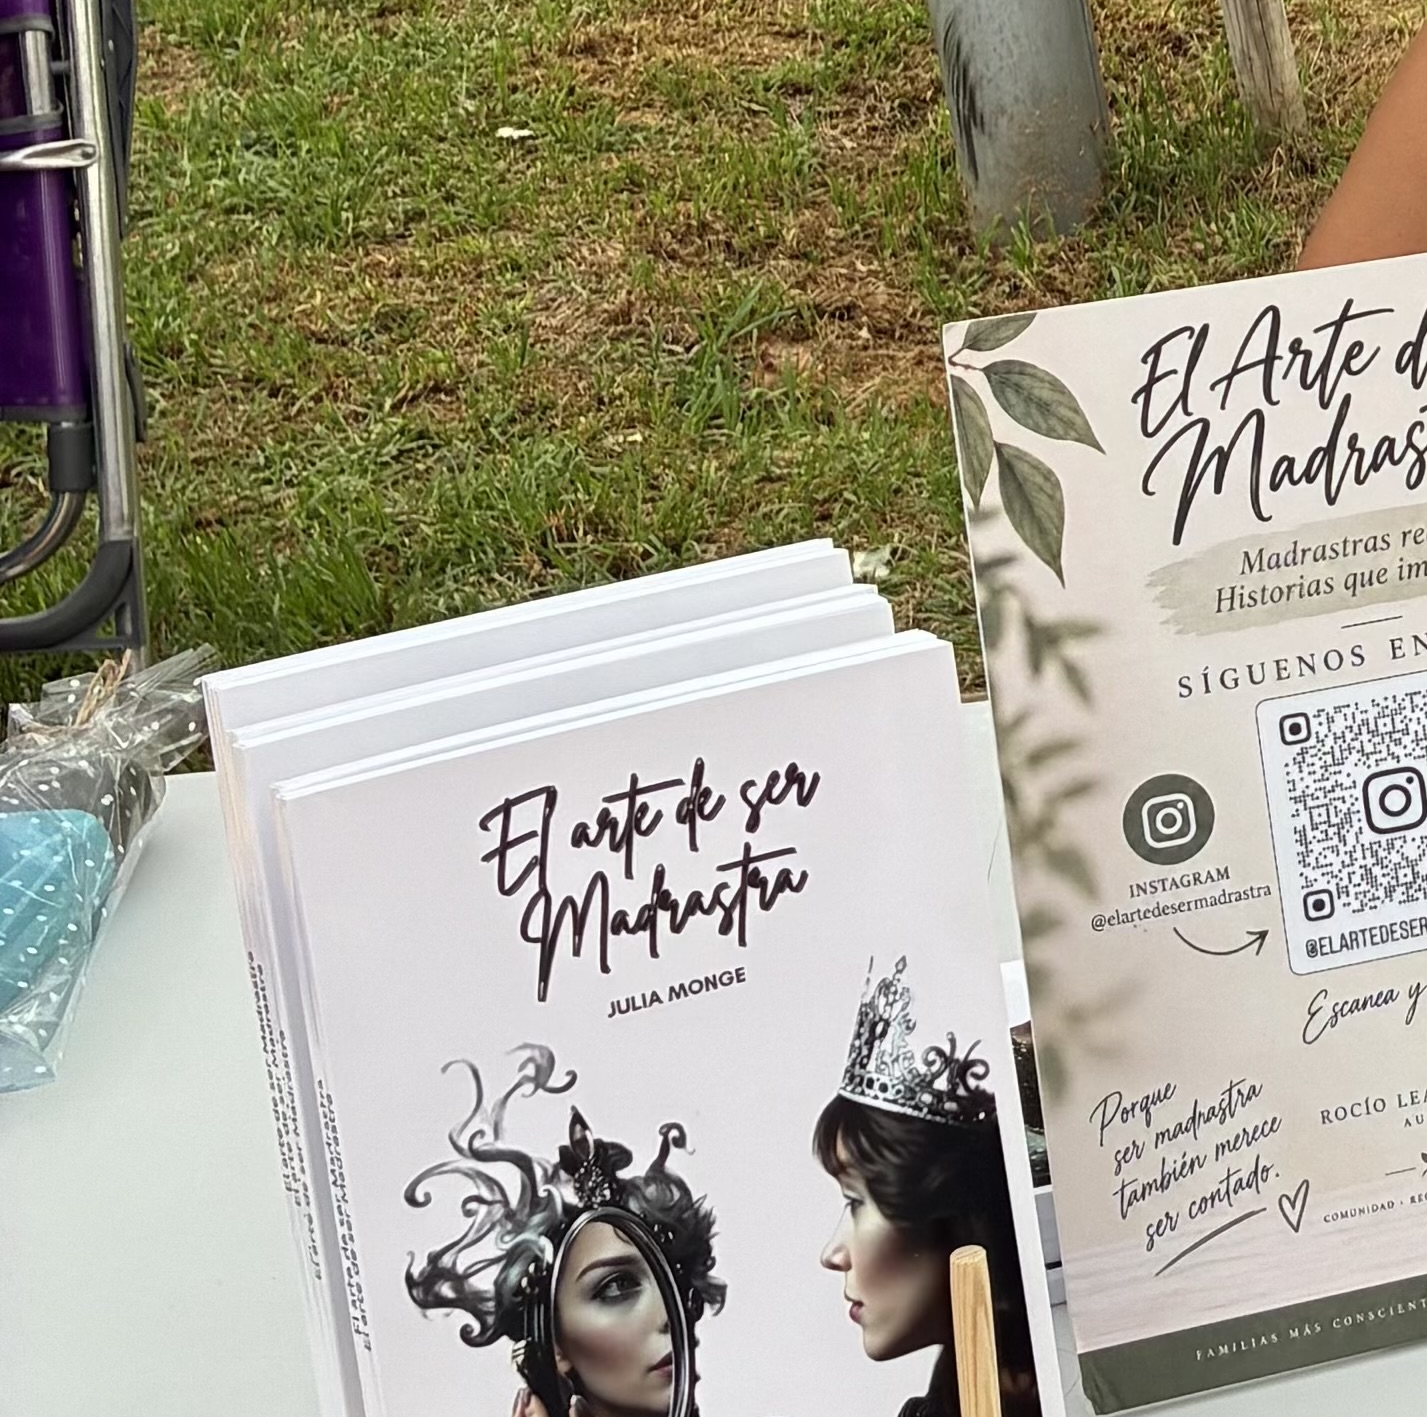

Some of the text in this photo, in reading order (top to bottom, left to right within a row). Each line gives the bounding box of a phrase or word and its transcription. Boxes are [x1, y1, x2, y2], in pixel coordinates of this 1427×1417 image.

[1131, 322, 1210, 438] El
[1209, 298, 1395, 410] Arte
[1239, 532, 1391, 576] Madrastras
[1215, 572, 1335, 614] Historias
[1343, 567, 1388, 598] que
[1177, 644, 1365, 699] SÍGUENOS
[479, 756, 822, 897] El arte de ser
[1091, 880, 1272, 933] @elartedesermadrastra
[1129, 865, 1232, 899] INSTAGRAM
[519, 842, 809, 1003] Madrastra
[607, 966, 747, 1019] JULIA MONGE
[1302, 988, 1400, 1045] Escanea
[1404, 981, 1427, 1026] y
[1088, 1082, 1177, 1147] Porque
[1114, 1078, 1263, 1177] ser madrastra
[1320, 1096, 1387, 1125] ROCÍO
[1112, 1116, 1283, 1220] también merece
[1146, 1153, 1280, 1252] ser contado.
